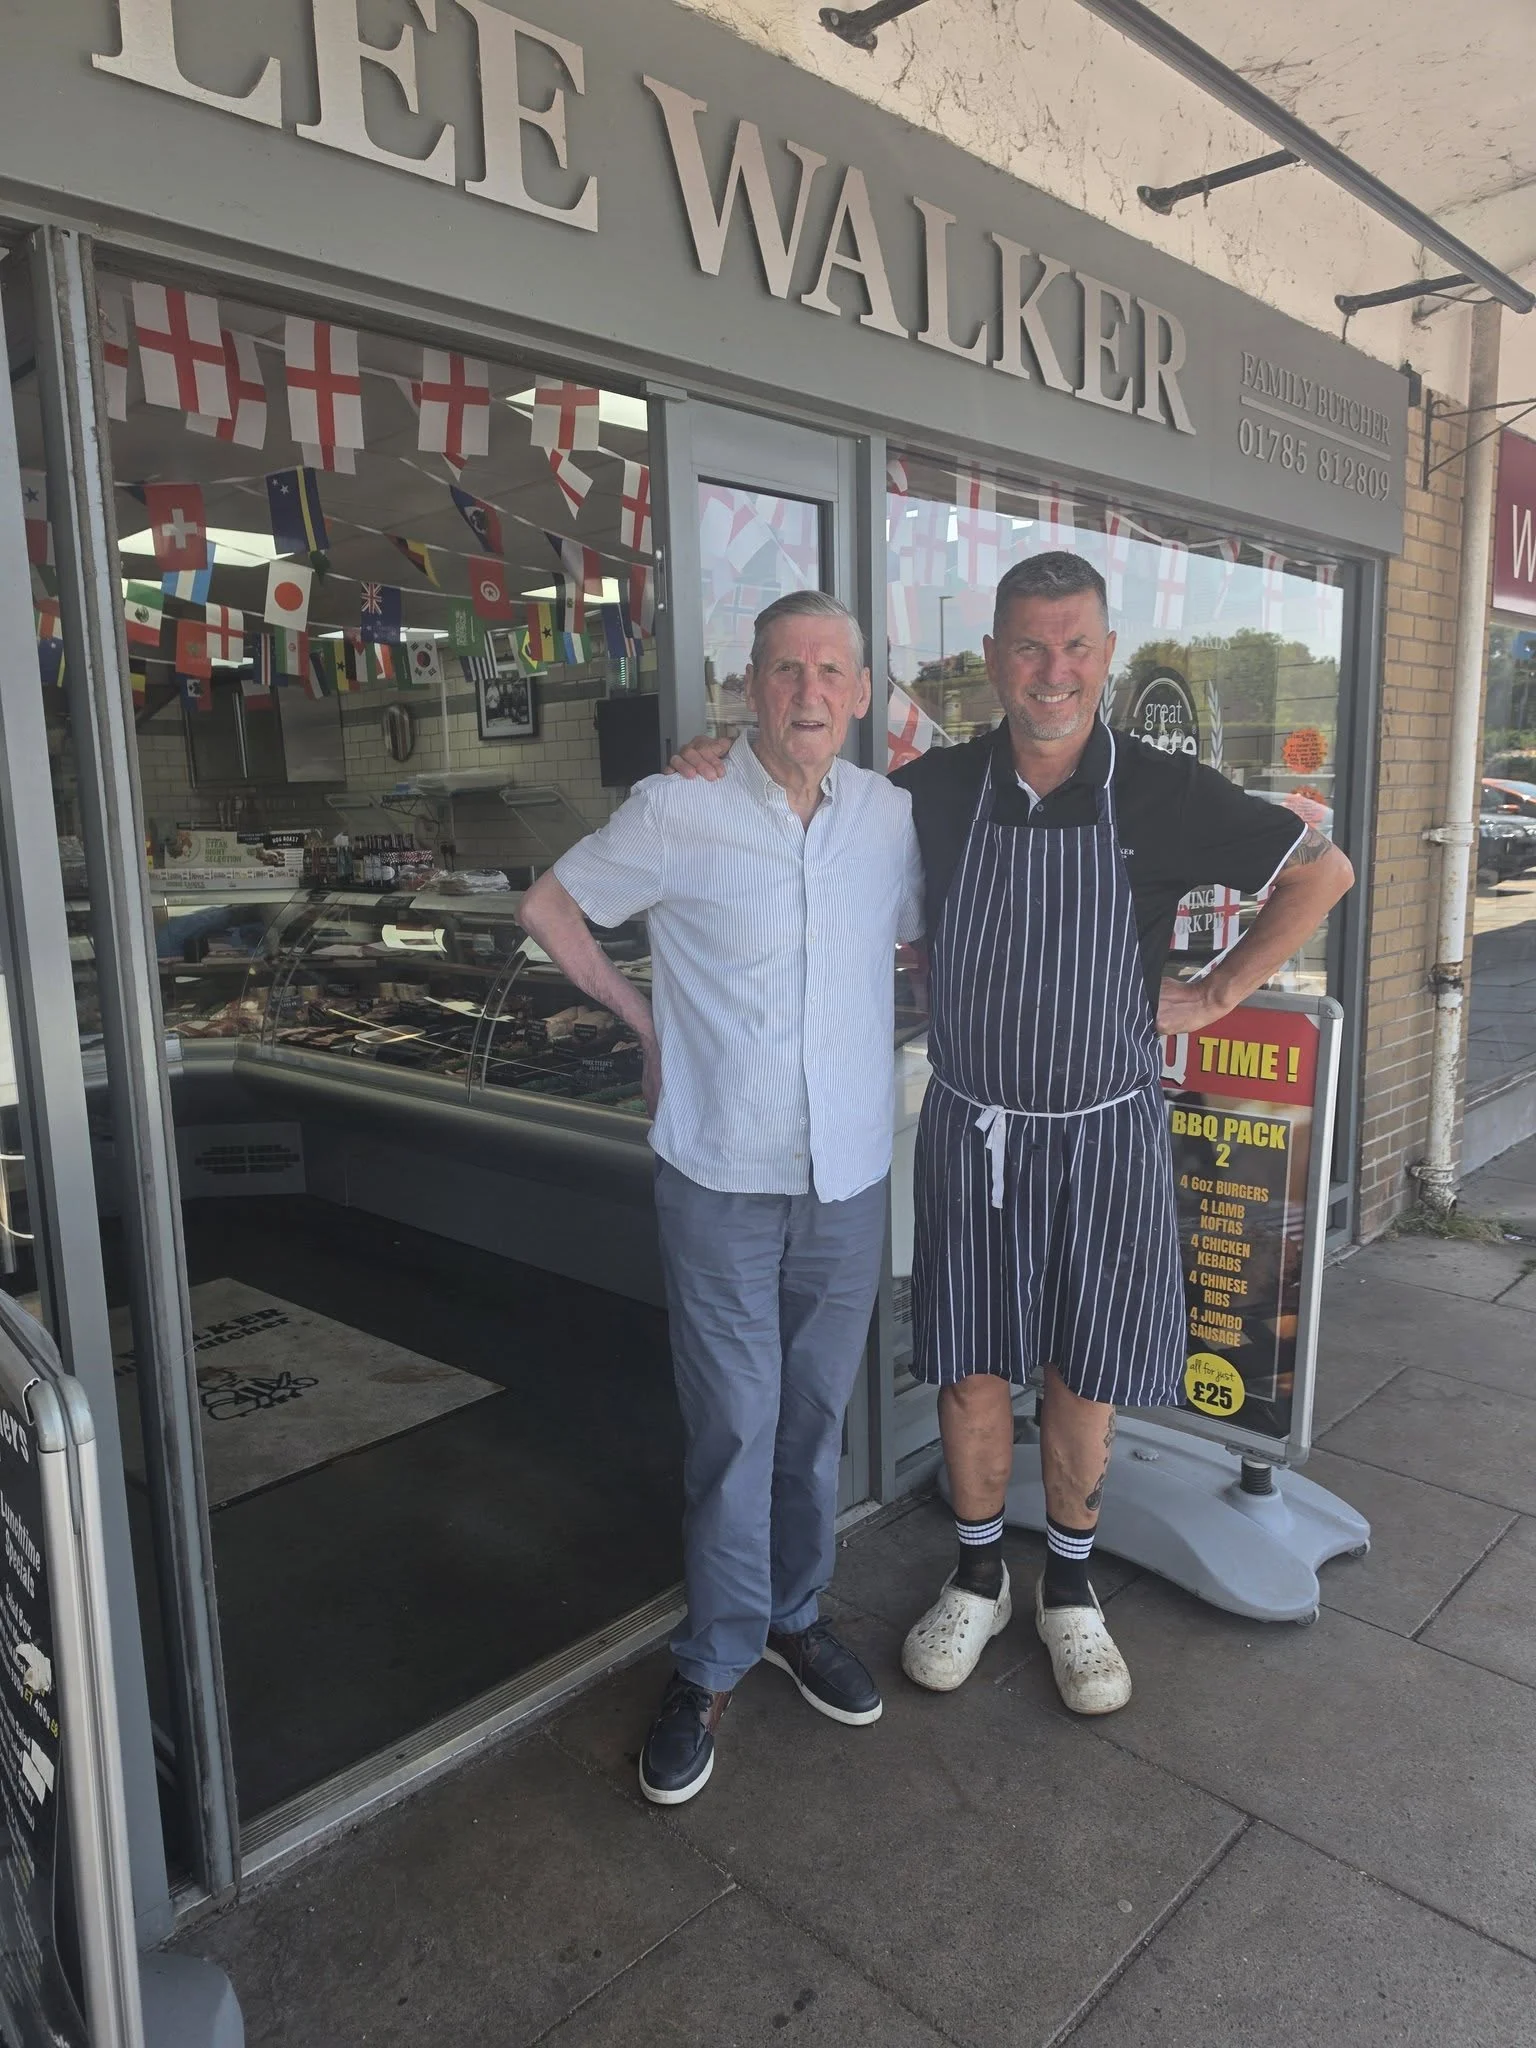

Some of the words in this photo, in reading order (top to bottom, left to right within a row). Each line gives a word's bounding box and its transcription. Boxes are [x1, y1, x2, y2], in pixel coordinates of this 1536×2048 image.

[91, 0, 599, 232] LEE
[642, 72, 1196, 436] WALKER
[1242, 351, 1313, 412] FAMILY
[1316, 385, 1391, 446] BUTCHER
[1239, 417, 1308, 474] 01785
[1318, 448, 1390, 501] 812809
[1145, 700, 1183, 731] great
[1120, 848, 1135, 856] KER
[1199, 1036, 1279, 1080] TIME
[1286, 1046, 1300, 1083] !
[1172, 1110, 1219, 1142] BBQ
[1223, 1117, 1286, 1150] PACK
[1216, 1143, 1231, 1168] 2
[1180, 1175, 1188, 1188] 4
[1216, 1180, 1269, 1203] BURGERS
[1200, 1199, 1208, 1212] 4
[1211, 1200, 1245, 1219] LAMB
[1201, 1215, 1243, 1235] KOFTAS
[1191, 1234, 1199, 1247] 4
[1202, 1236, 1251, 1258] CHICKEN
[1198, 1251, 1242, 1272] KEBABS
[1189, 1270, 1198, 1284] 4
[1200, 1272, 1248, 1295] CHINESE
[1204, 1289, 1230, 1308] RIBS
[1190, 1306, 1198, 1320] 4
[1201, 1309, 1243, 1330] JUMBO
[1190, 1322, 1241, 1347] SAUSAGE
[1190, 1359, 1202, 1375] all
[1203, 1363, 1216, 1376] for
[1215, 1370, 1236, 1382] just
[1193, 1380, 1233, 1410] £25
[0, 1408, 29, 1464] ers
[0, 1489, 40, 1573] Lunchtime
[5, 1528, 35, 1599] Specials
[18, 1608, 32, 1640] Box
